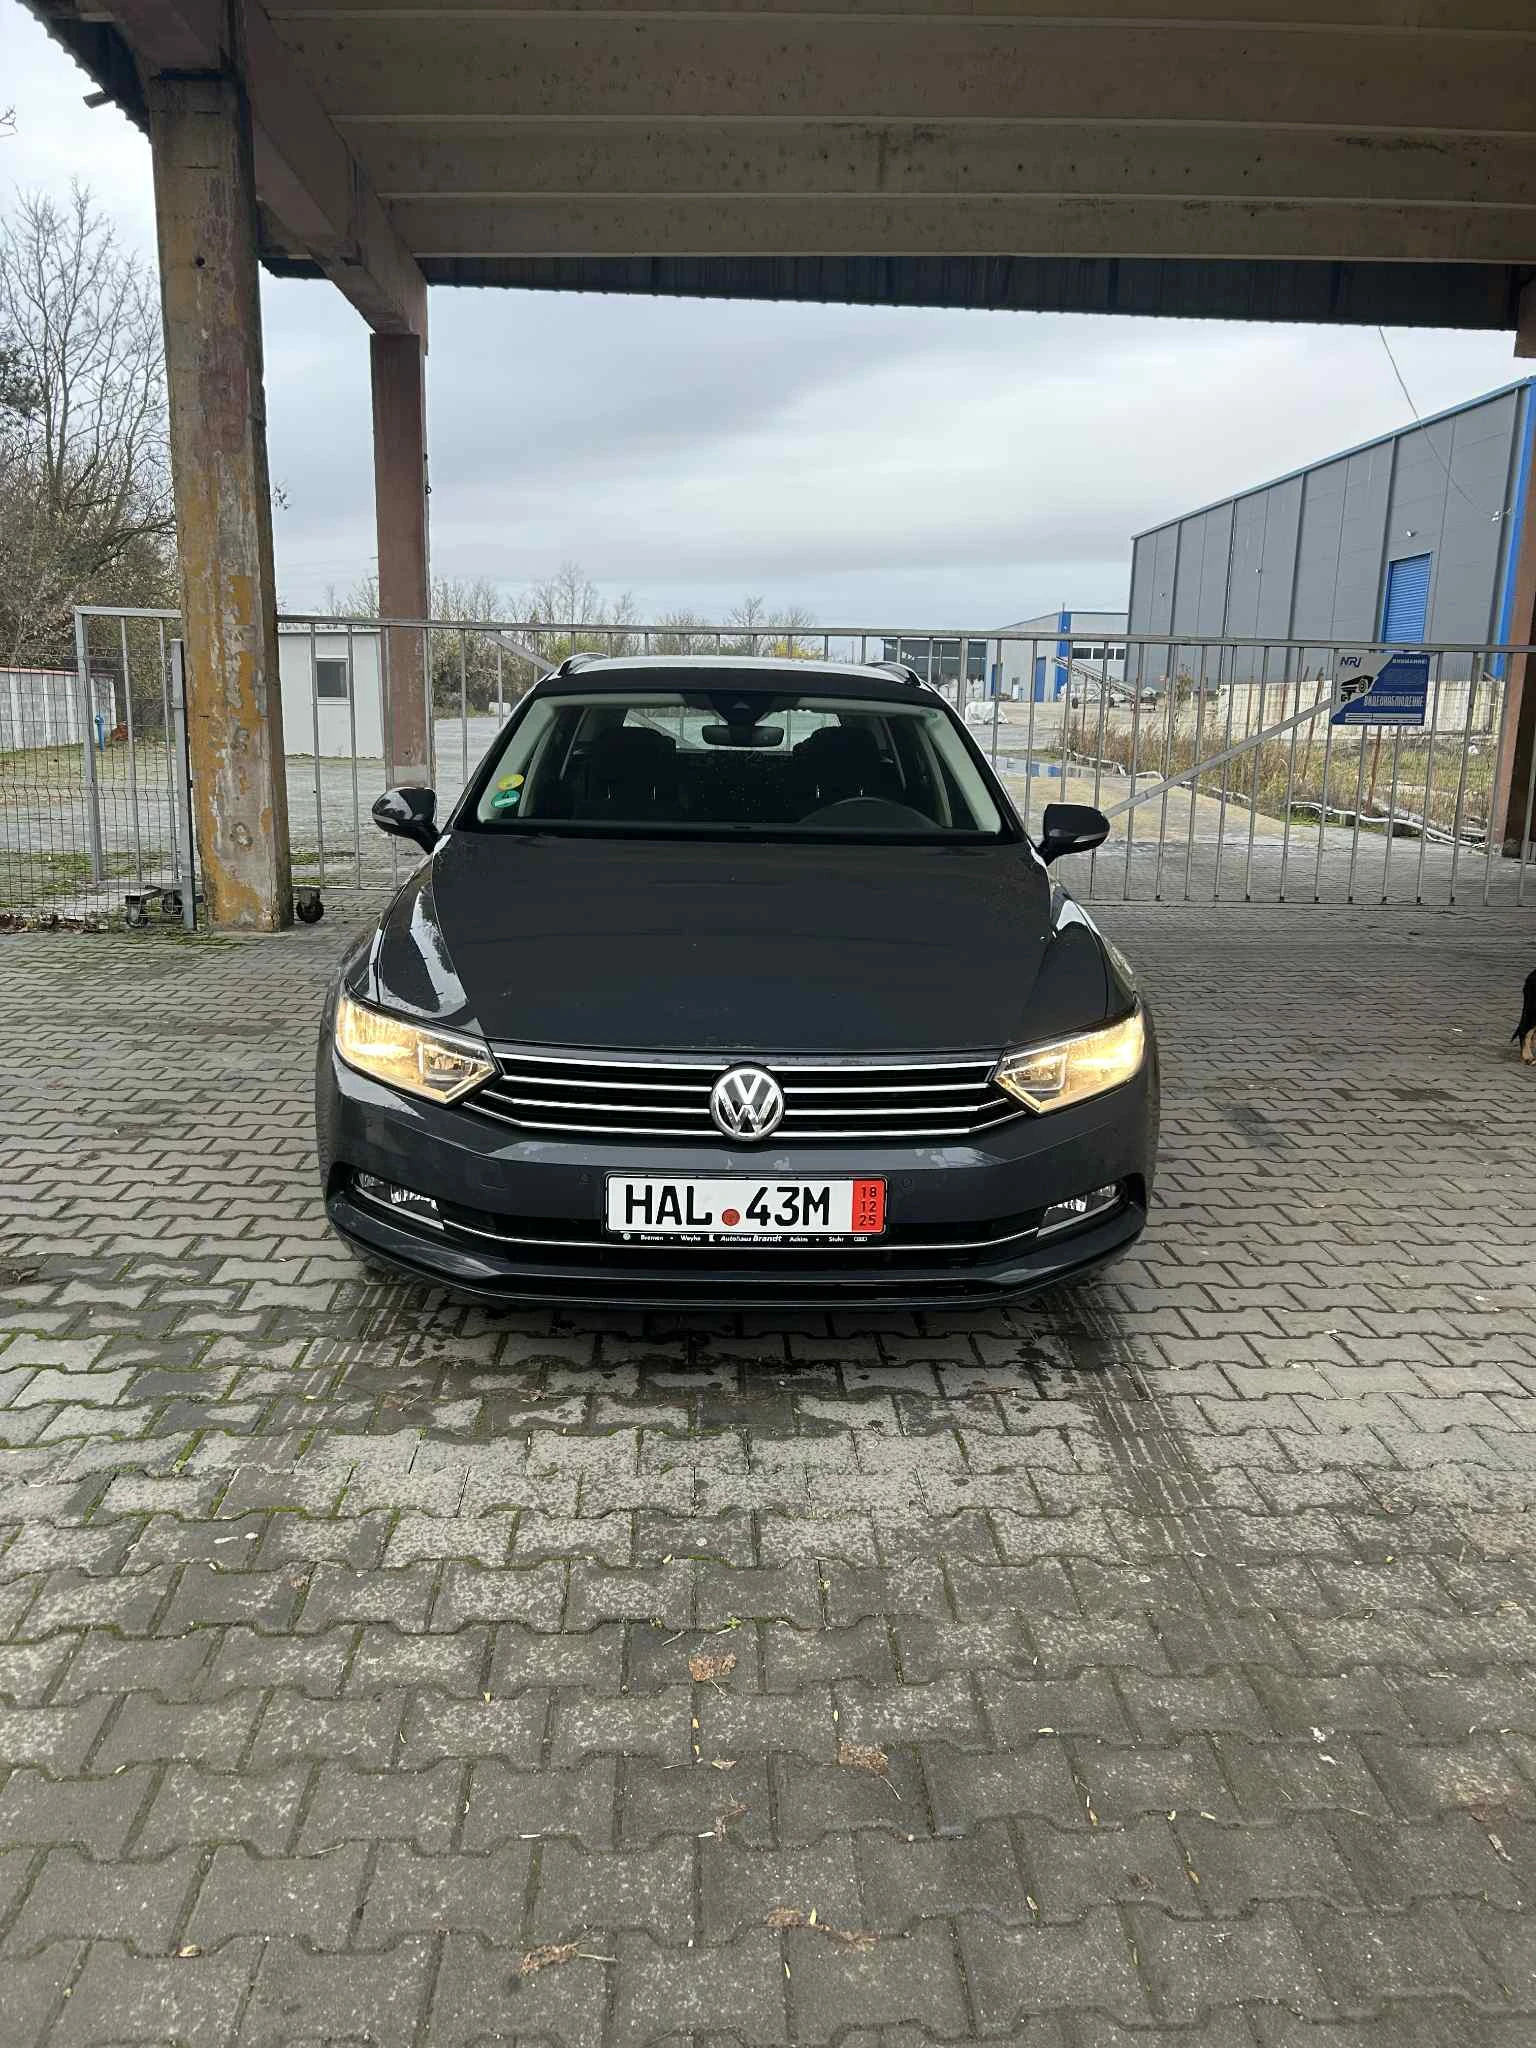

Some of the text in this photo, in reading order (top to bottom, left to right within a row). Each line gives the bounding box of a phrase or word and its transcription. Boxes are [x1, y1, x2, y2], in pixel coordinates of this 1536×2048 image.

[715, 1070, 779, 1136] VW
[861, 1186, 877, 1198] 18
[625, 1184, 830, 1227] HAL 43M
[861, 1201, 877, 1212] 12
[859, 1215, 876, 1226] 25
[640, 1233, 664, 1241] Bremen
